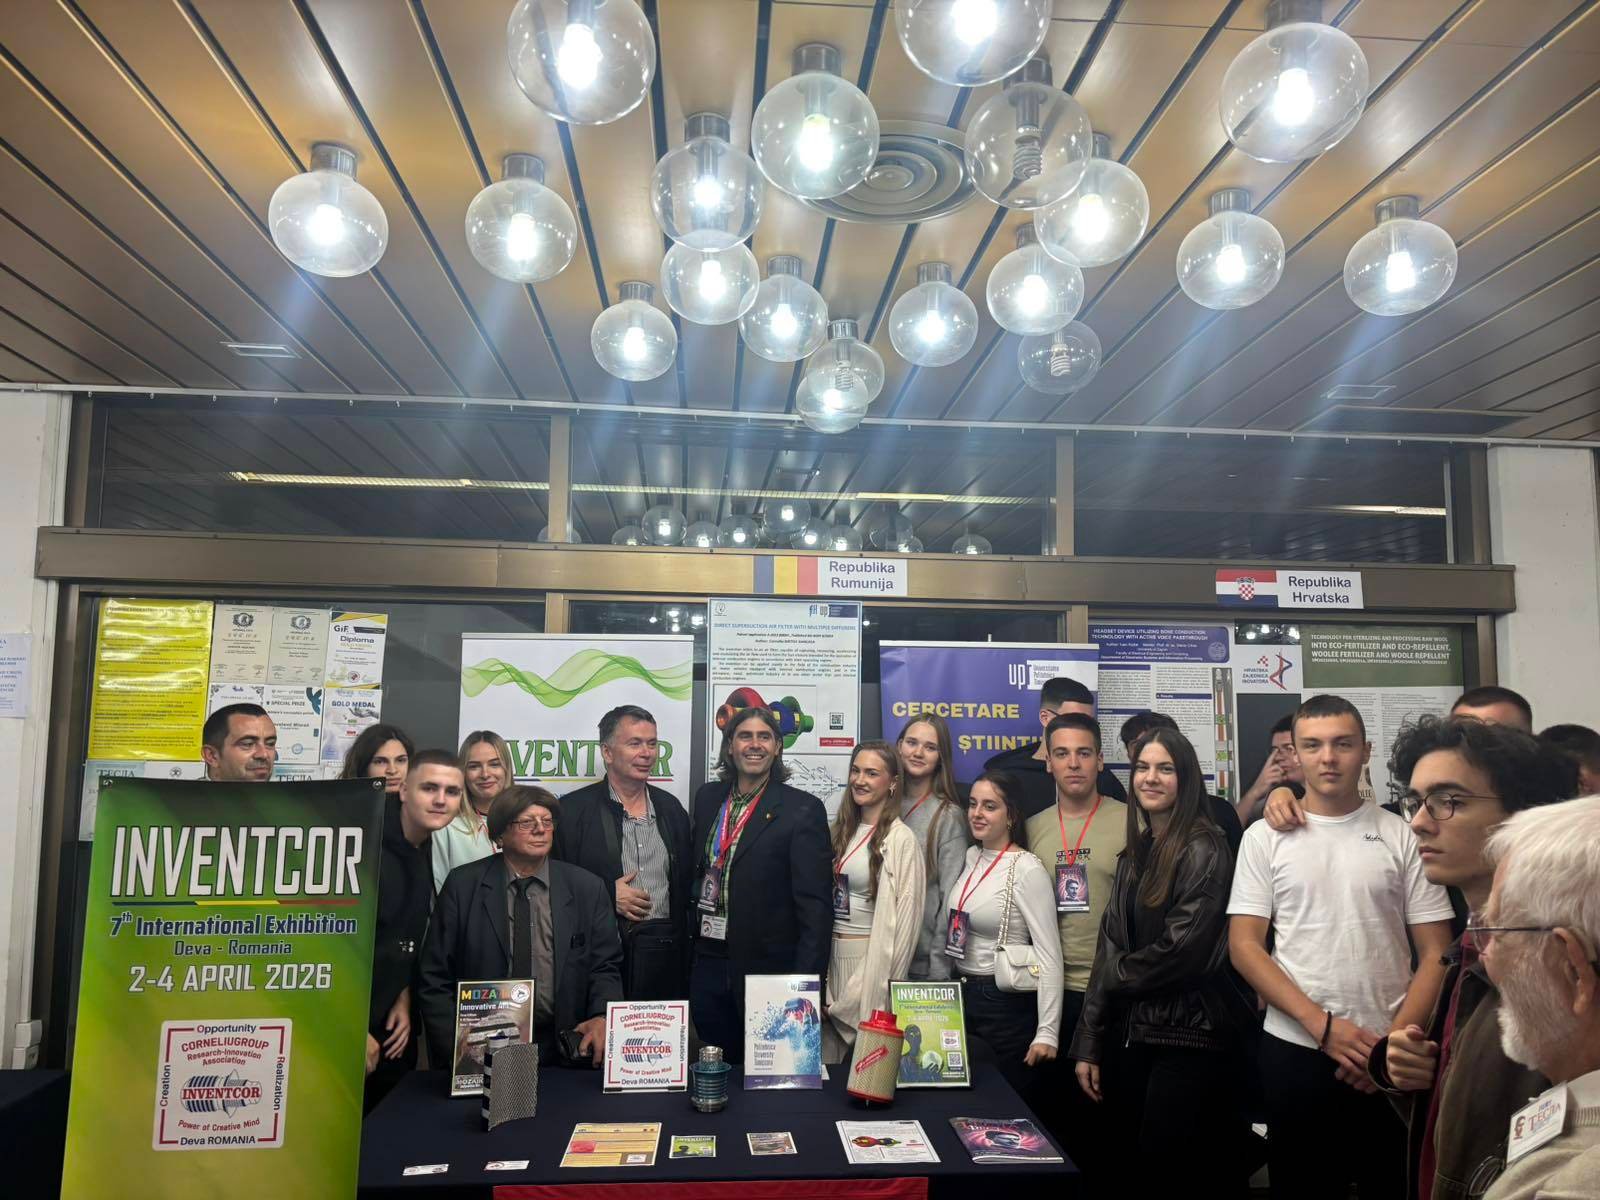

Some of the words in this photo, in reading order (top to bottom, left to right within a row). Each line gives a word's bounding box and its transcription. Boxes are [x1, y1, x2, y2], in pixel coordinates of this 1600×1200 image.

[829, 560, 896, 575] Republika
[831, 577, 894, 592] Rumunija
[1288, 576, 1352, 589] Republika
[1292, 592, 1350, 604] Hrvatska
[340, 635, 375, 644] Diploma
[1328, 642, 1381, 650] ECO-FERTILIZER
[892, 701, 1020, 719] CERCETARE
[110, 825, 364, 897] INVENTCOR
[110, 911, 133, 937] 7th
[136, 914, 262, 936] International
[264, 913, 358, 935] Exhibition
[173, 940, 212, 957] Deva
[228, 939, 292, 955] Romania
[128, 965, 174, 993] 2-4
[182, 964, 256, 992] APRIL
[264, 963, 333, 991] 2026
[897, 988, 955, 1000] INVENTCOR
[460, 1003, 497, 1011] Innovative
[620, 1012, 676, 1022] CORNELIUGROUP
[196, 1024, 257, 1035] Opportunity
[181, 1037, 269, 1052] CORNELIUGROUP
[621, 1046, 672, 1054] INVENTCOR
[187, 1049, 262, 1061] Research-Innovation
[202, 1056, 246, 1067] Association
[160, 1064, 171, 1107] Creation
[273, 1056, 286, 1111] Realization
[182, 1086, 261, 1100] INVENTCOR
[178, 1119, 200, 1130] Power
[202, 1123, 210, 1131] of
[212, 1123, 241, 1132] Creative
[243, 1117, 260, 1129] Mind
[180, 1136, 206, 1146] Deva
[207, 1135, 256, 1145] ROMANIA
